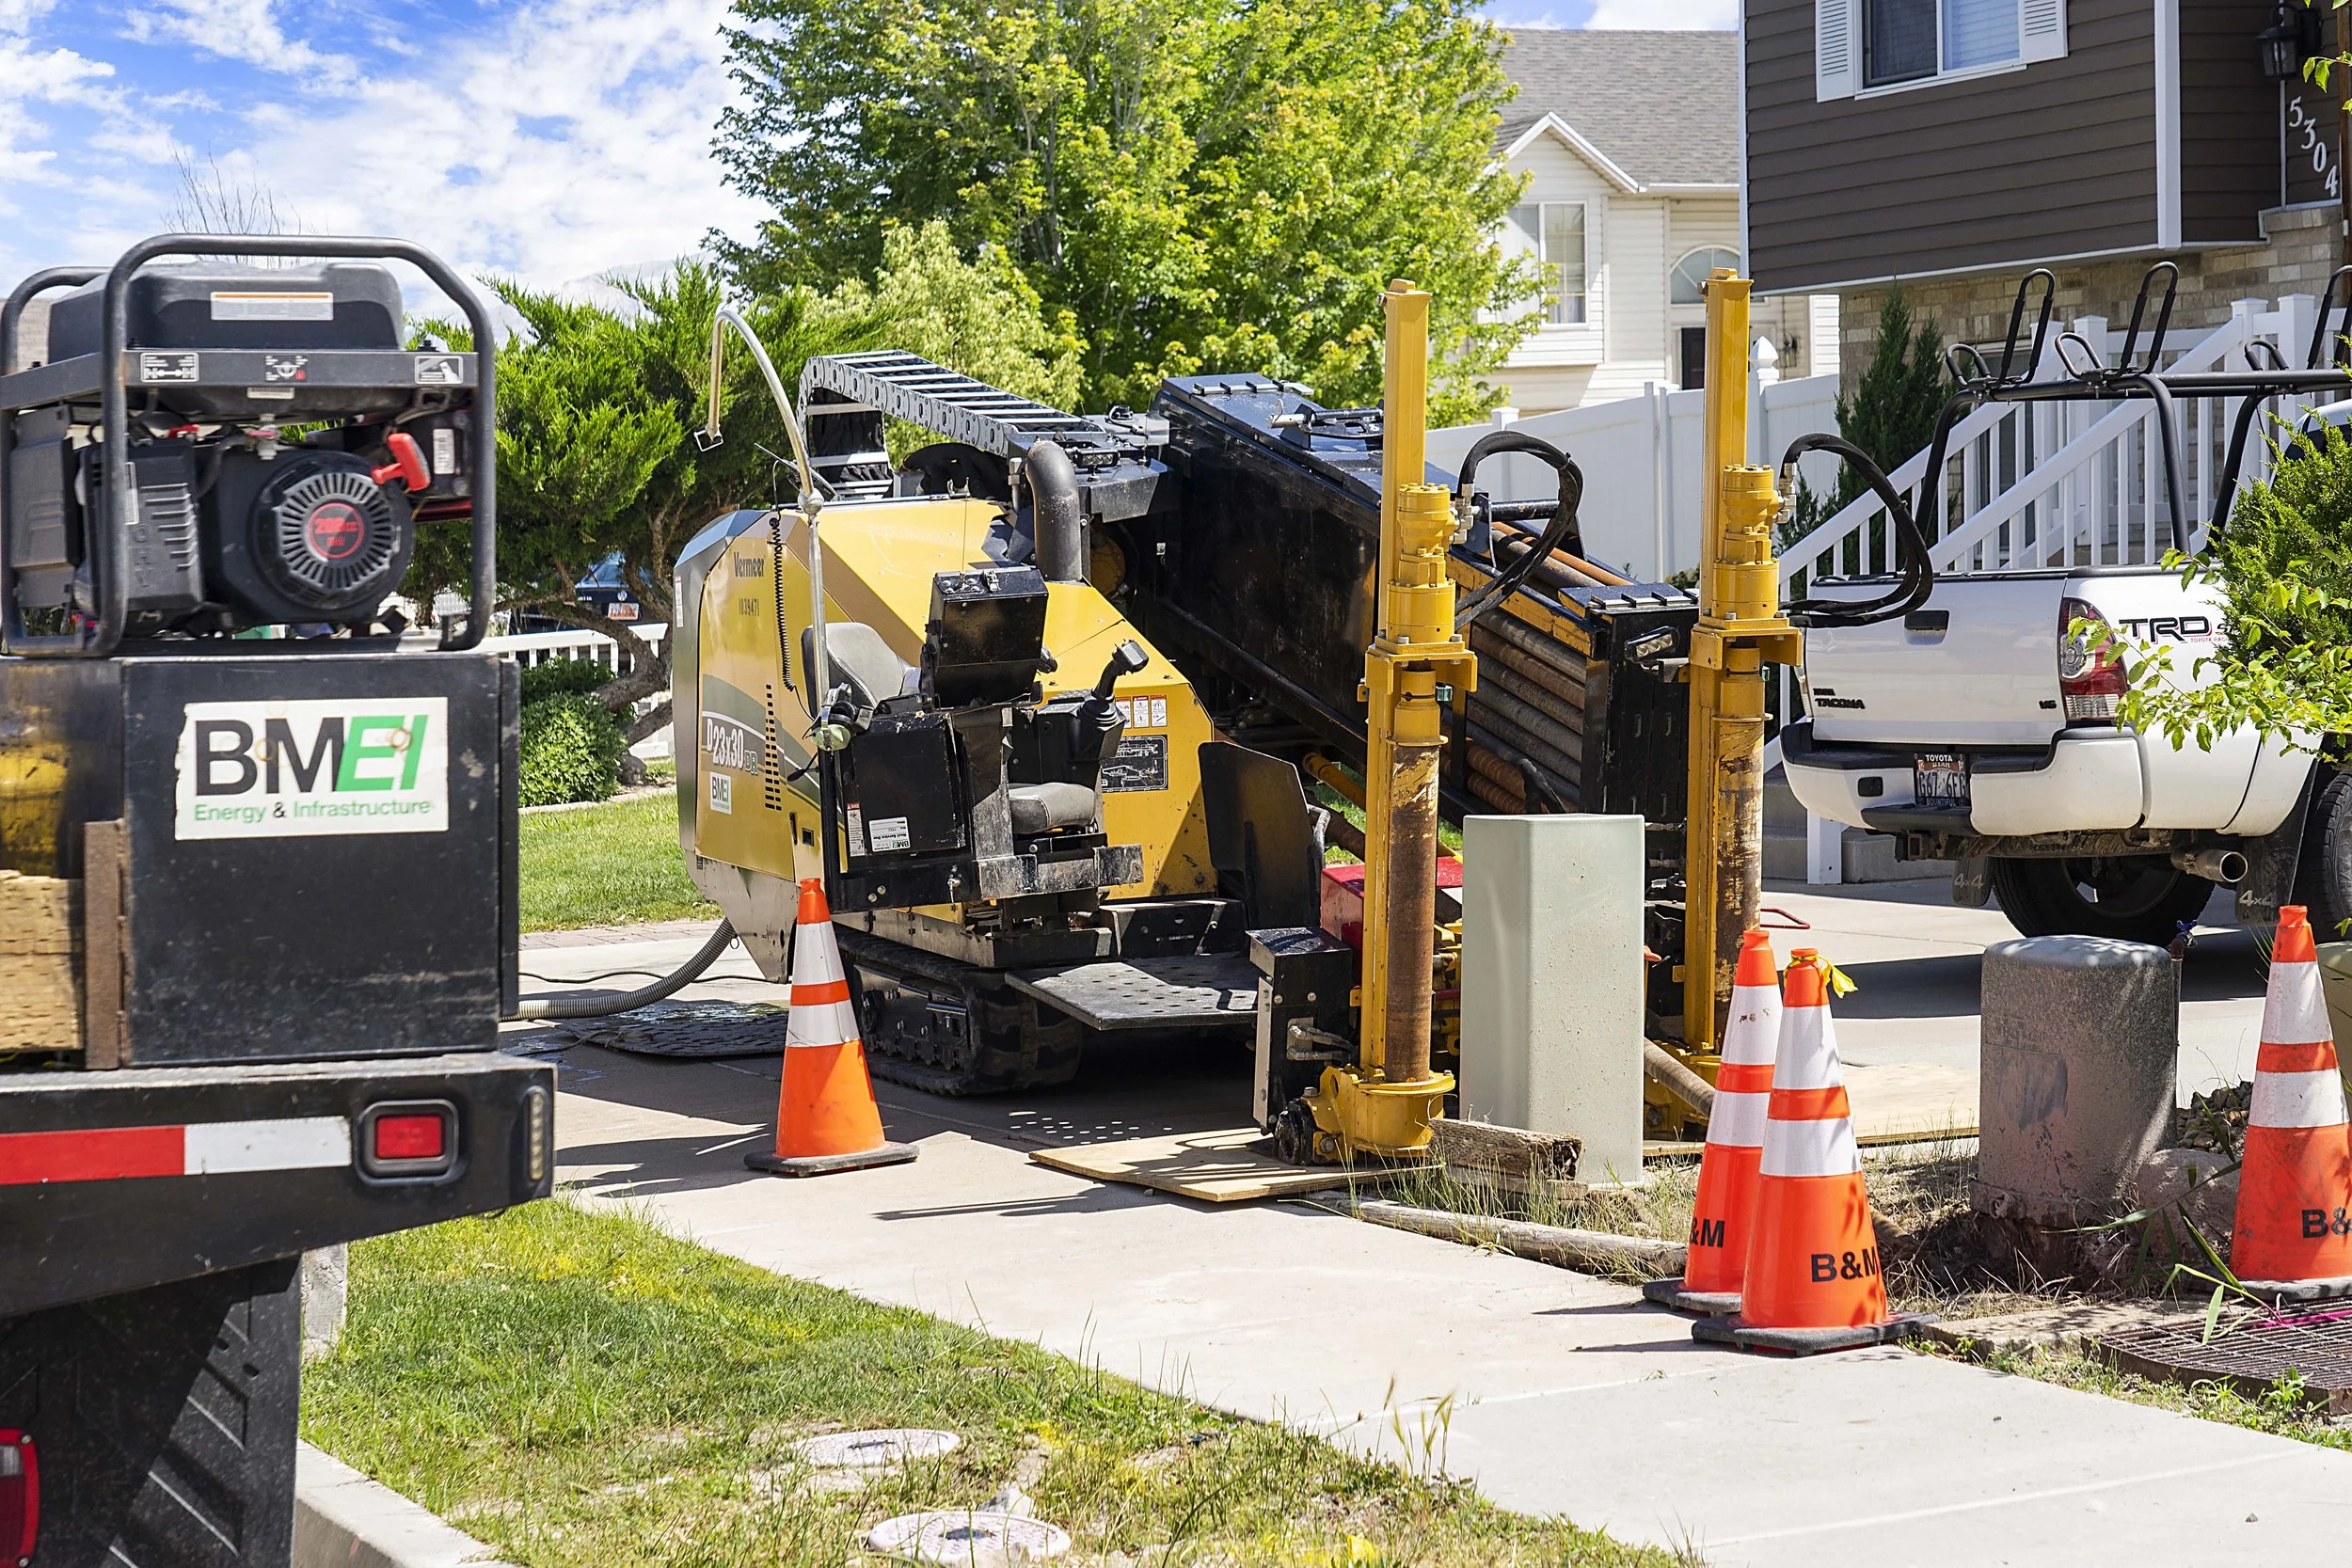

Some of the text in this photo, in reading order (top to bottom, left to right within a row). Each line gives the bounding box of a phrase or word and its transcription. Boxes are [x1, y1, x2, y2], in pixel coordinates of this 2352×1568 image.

[2289, 96, 2339, 198] 5304
[734, 551, 764, 578] Vermeer
[2119, 616, 2212, 644] TRD
[1815, 698, 1866, 709] TACOMA
[2039, 700, 2058, 709] V6
[194, 714, 429, 797] BMEI
[707, 718, 744, 769] D23x30
[195, 799, 430, 824] Energy & Infrastructure
[1954, 873, 1984, 889] 4x4
[2239, 890, 2277, 908] 4x4
[1690, 1216, 1725, 1248] &M
[2301, 1207, 2352, 1239] B&
[1811, 1246, 1880, 1283] B&M
